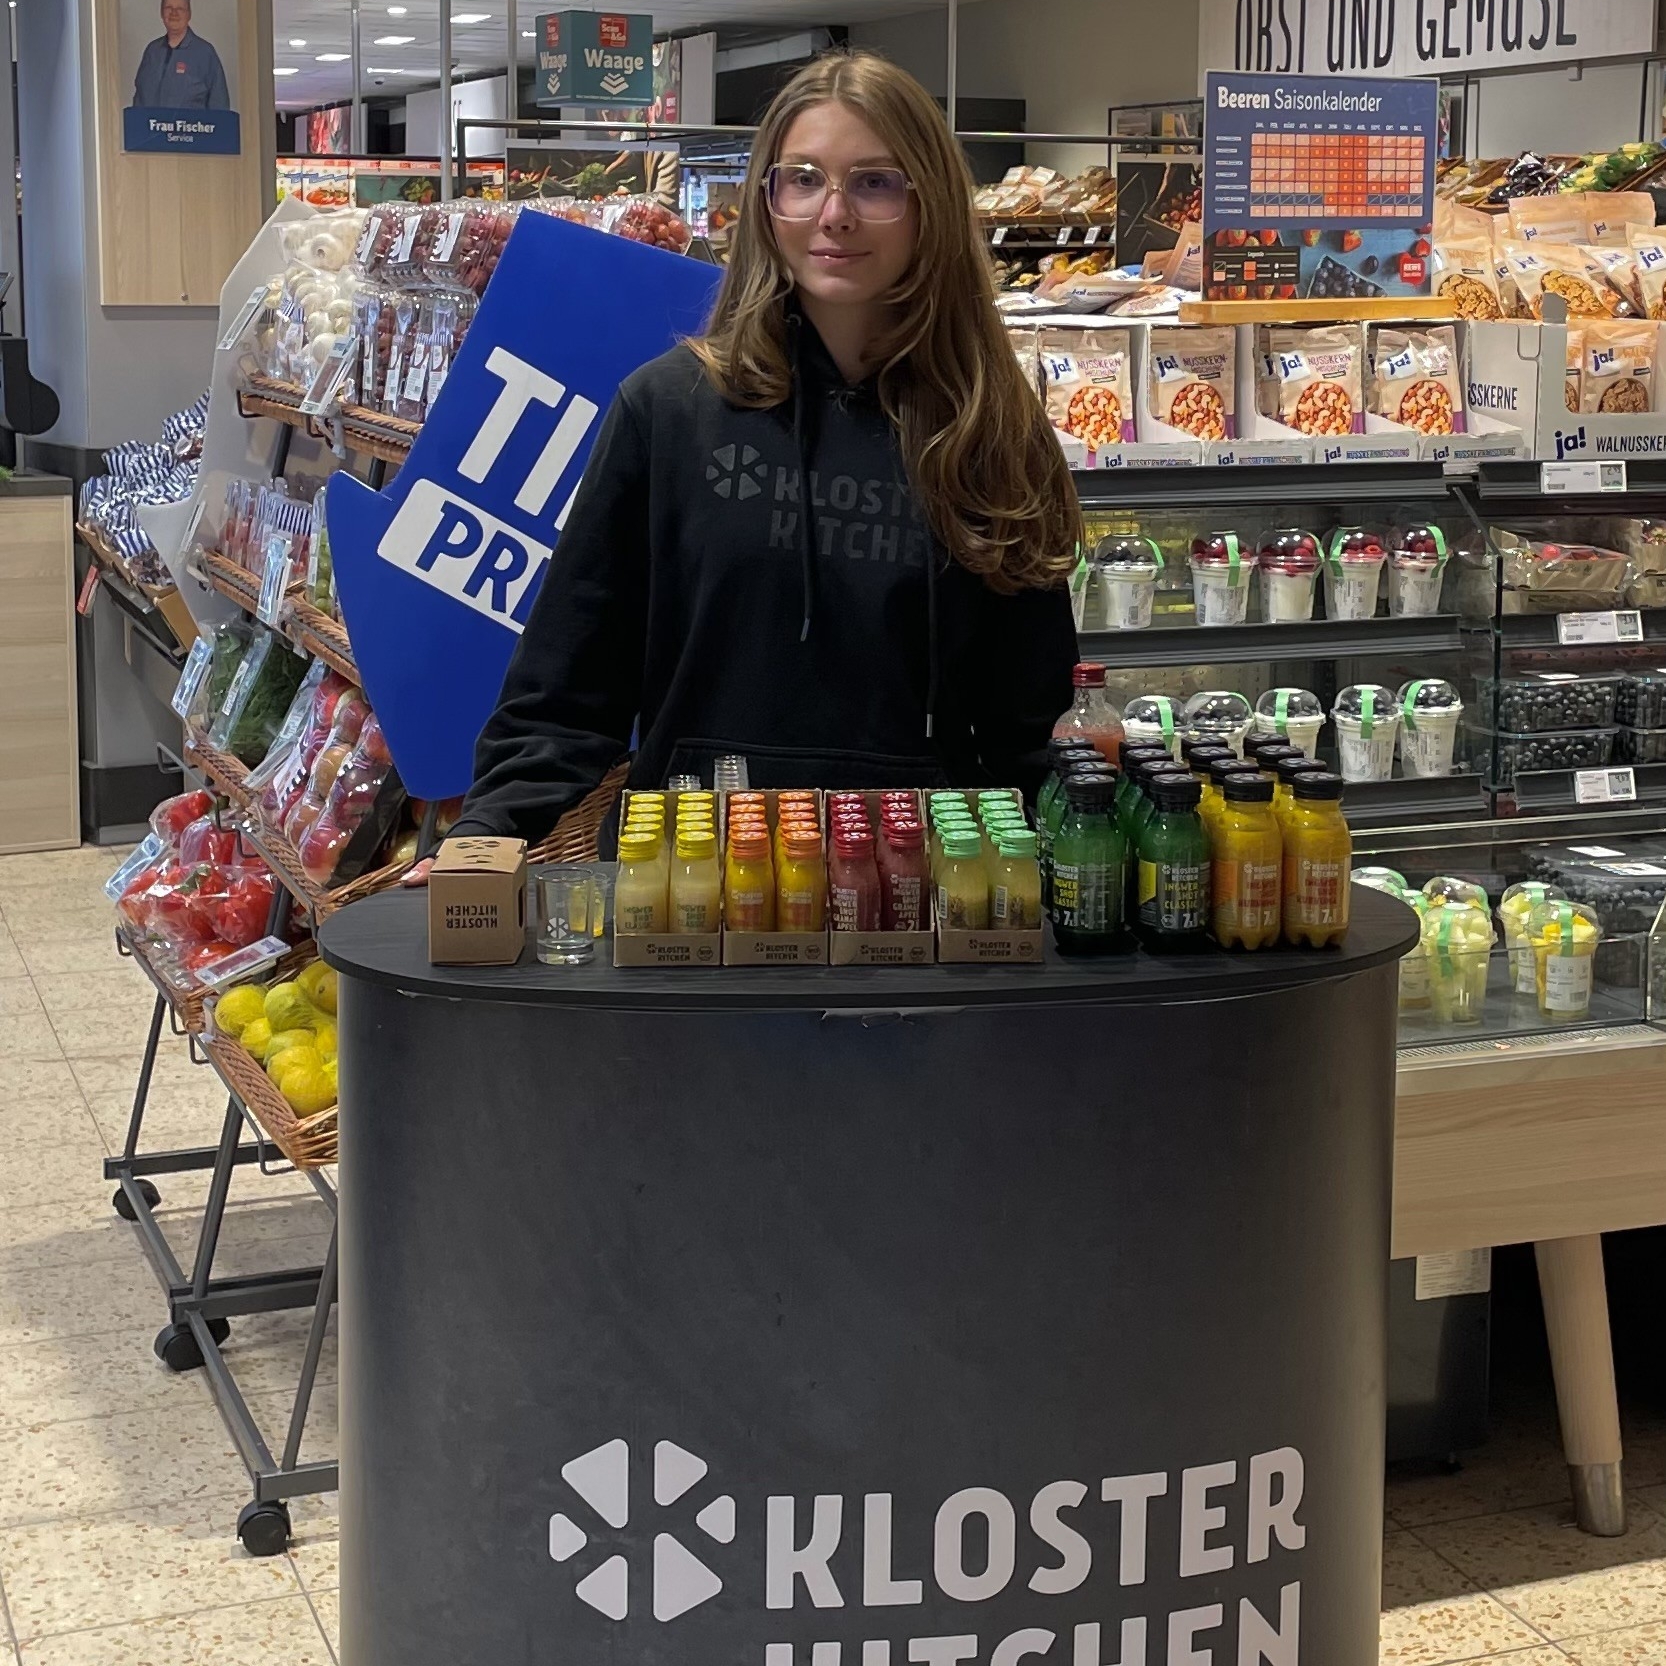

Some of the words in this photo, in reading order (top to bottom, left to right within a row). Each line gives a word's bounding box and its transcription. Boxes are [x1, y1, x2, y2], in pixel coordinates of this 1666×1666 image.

[1326, 0, 1395, 73] UND
[584, 48, 644, 75] Waage
[1217, 86, 1270, 110] Beeren
[1274, 88, 1383, 112] Saisonkalender
[149, 119, 174, 132] Frau
[176, 120, 216, 133] Fischer
[167, 132, 194, 143] Service
[1639, 246, 1664, 269] ja!
[1050, 357, 1072, 380] ja!
[1156, 355, 1179, 378] ja!
[1280, 355, 1303, 378] ja!
[1386, 352, 1411, 376] ja!
[1592, 348, 1614, 372] ja!
[1469, 382, 1518, 411] SSKERNE
[457, 346, 598, 532] TI
[1554, 426, 1587, 460] ja!
[1105, 453, 1123, 468] ja!
[1217, 452, 1235, 466] ja!
[1324, 446, 1342, 463] ja!
[1433, 446, 1450, 461] ja!
[1164, 882, 1199, 891] INGWER
[1176, 891, 1199, 901] SHOT
[445, 905, 498, 916] KITCHEN
[1164, 900, 1198, 910] CLASSIC
[445, 918, 498, 929] KLOSTER
[766, 1446, 1307, 1610] KLOSTER
